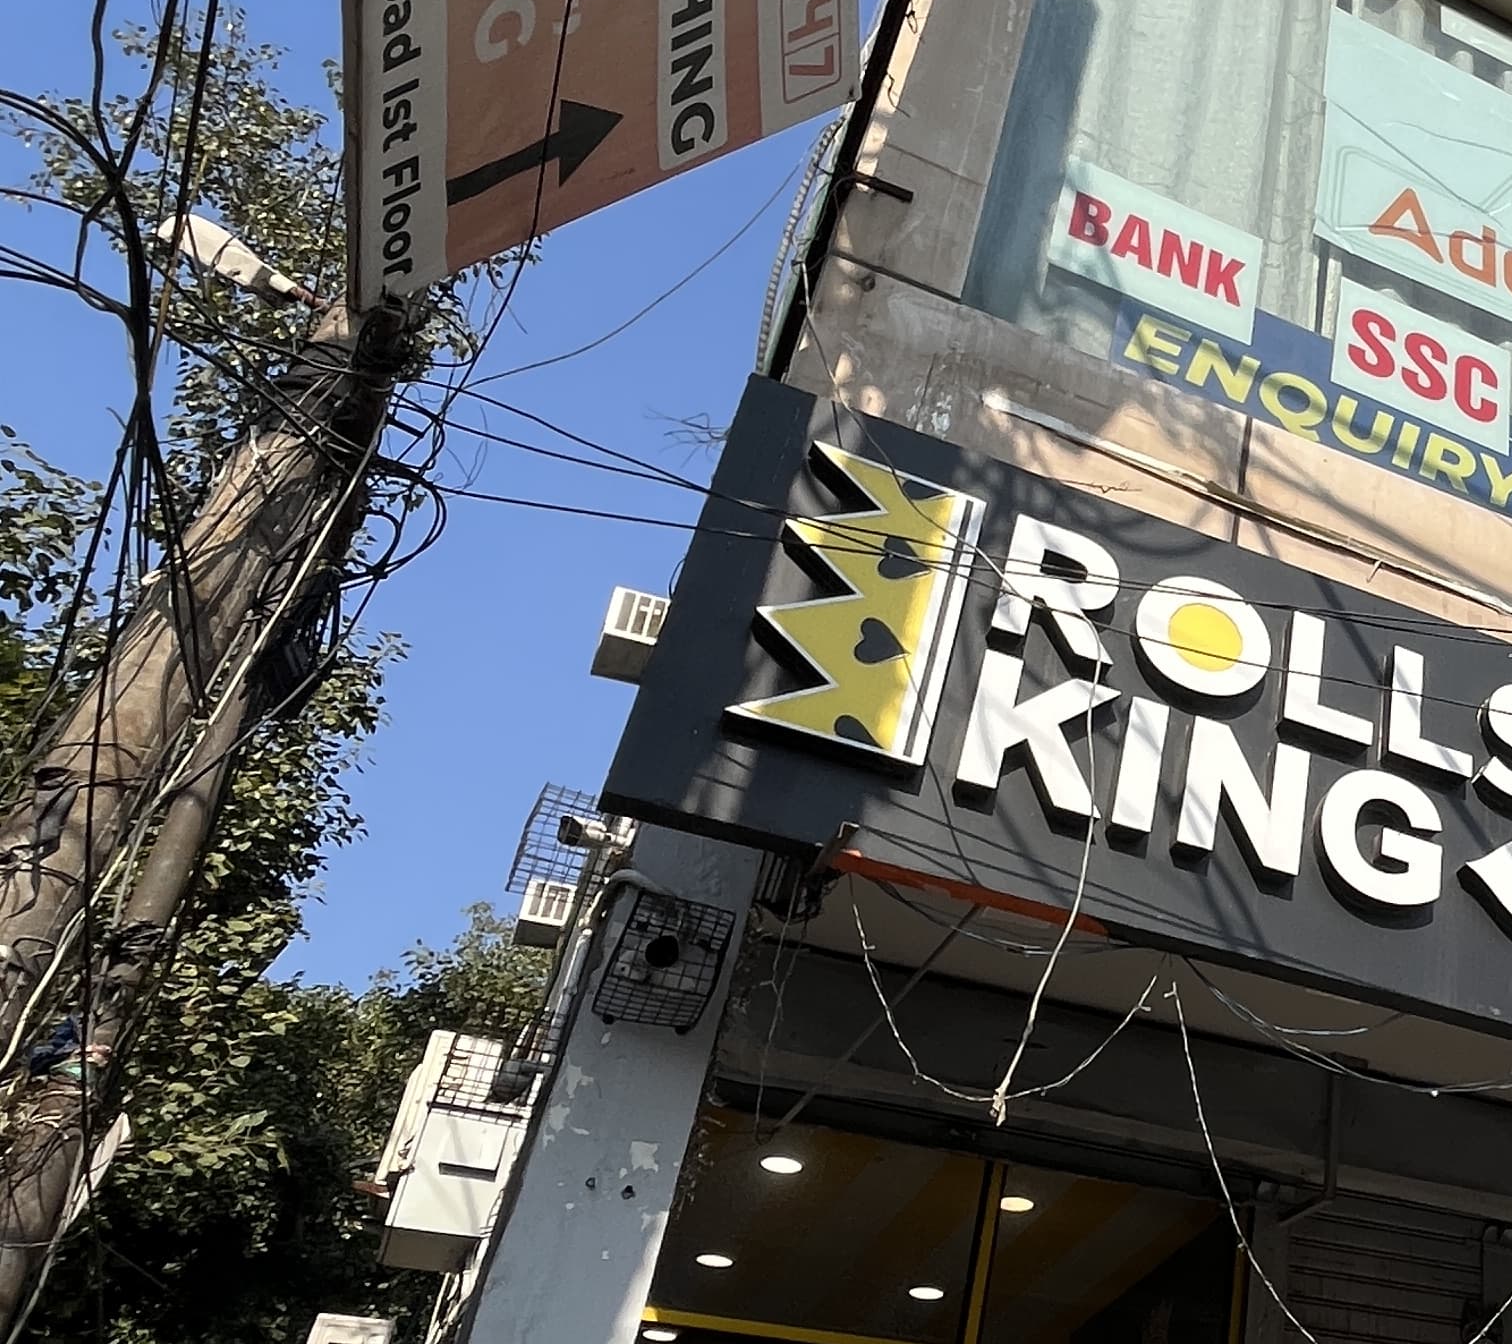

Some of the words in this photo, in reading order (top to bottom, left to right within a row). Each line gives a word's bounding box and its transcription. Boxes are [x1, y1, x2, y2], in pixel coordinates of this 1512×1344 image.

[380, 158, 419, 277] Floor
[1068, 192, 1246, 307] BANK
[1347, 308, 1498, 423] SSC
[954, 648, 1443, 907] KING
